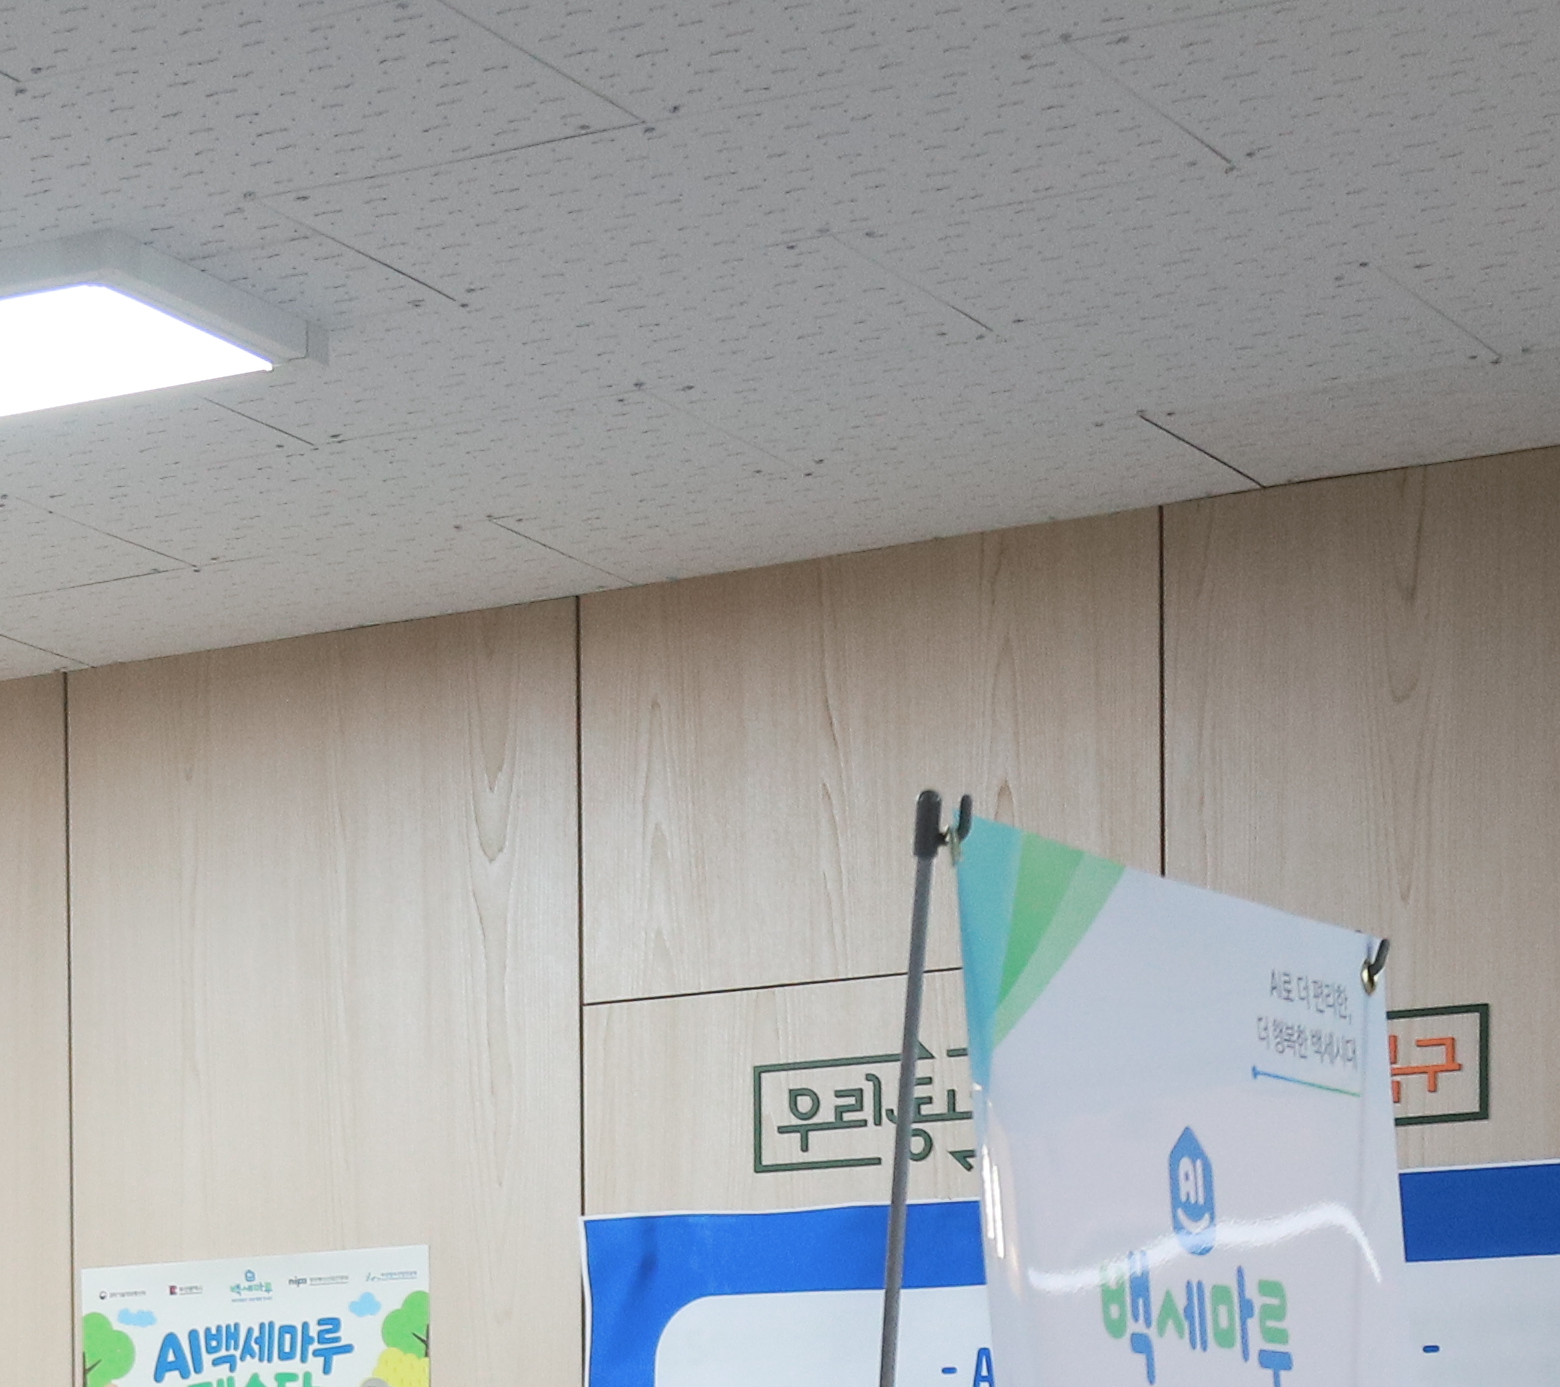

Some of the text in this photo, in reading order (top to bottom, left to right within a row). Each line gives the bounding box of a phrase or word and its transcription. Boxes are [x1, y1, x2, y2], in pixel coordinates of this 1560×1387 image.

[1271, 969, 1294, 1002] AI로
[1297, 976, 1310, 1010] 더
[1257, 1016, 1358, 1071] 더 행복한 백세시대
[1180, 1155, 1206, 1206] AI
[153, 1317, 353, 1383] AI백세마루
